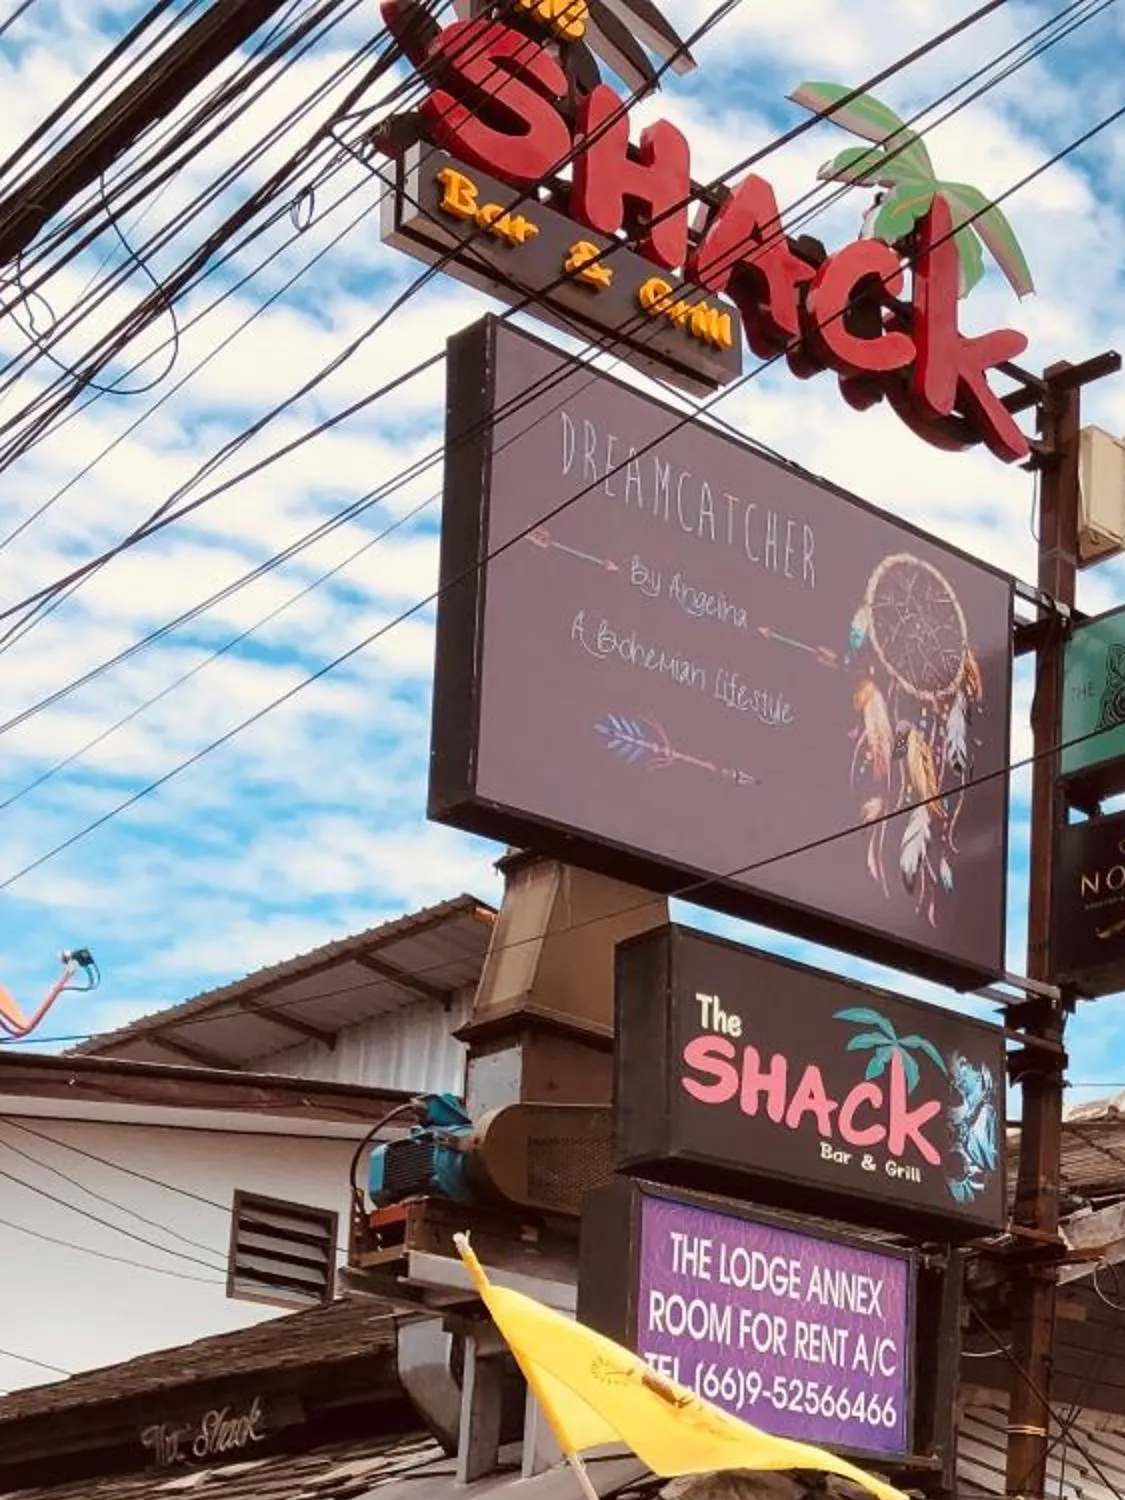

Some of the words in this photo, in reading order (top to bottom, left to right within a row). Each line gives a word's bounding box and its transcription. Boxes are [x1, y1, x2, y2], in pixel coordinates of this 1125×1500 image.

[564, 240, 613, 288] &
[560, 410, 817, 590] DREAMCATCHER
[630, 554, 662, 597] By
[597, 617, 706, 690] Bohemian
[713, 668, 794, 726] Lifestyle
[695, 992, 743, 1037] The
[681, 1034, 943, 1166] SHACK
[819, 1141, 851, 1166] Bar
[860, 1149, 877, 1173] &
[884, 1159, 922, 1184] Grill
[670, 1231, 713, 1282] THE
[718, 1242, 801, 1300] LODGE
[807, 1264, 884, 1318] ANNEX
[649, 1289, 732, 1346] ROOM
[738, 1308, 788, 1357] FOR
[794, 1320, 849, 1368] RENT
[852, 1335, 897, 1378] A/C
